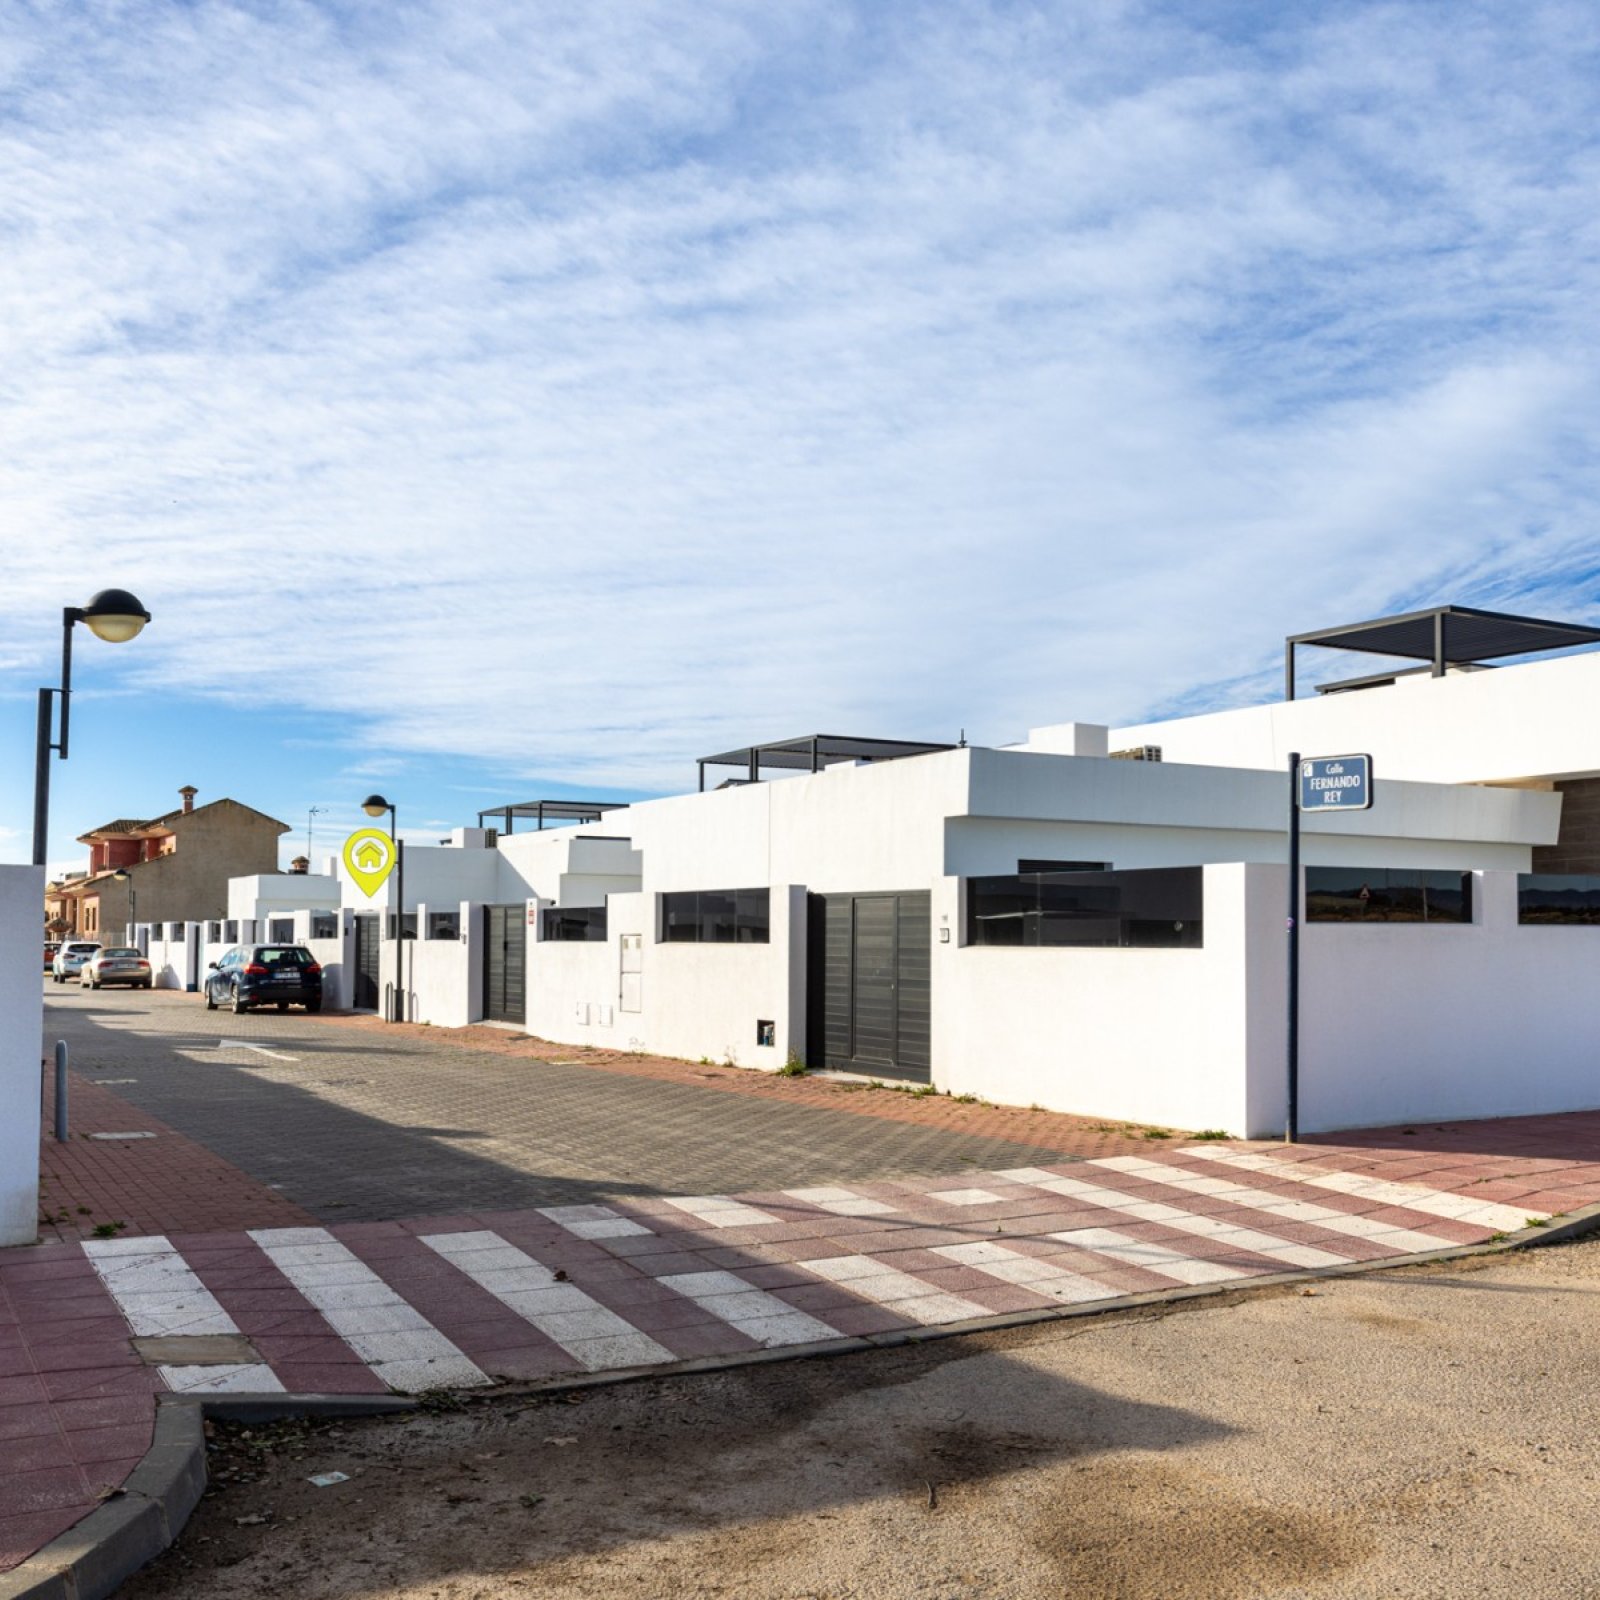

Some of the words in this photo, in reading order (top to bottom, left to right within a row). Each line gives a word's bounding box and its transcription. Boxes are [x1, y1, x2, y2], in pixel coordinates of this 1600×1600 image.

[1326, 763, 1344, 774] Calle
[1310, 775, 1361, 790] FERNANDO
[1324, 790, 1342, 803] REY
